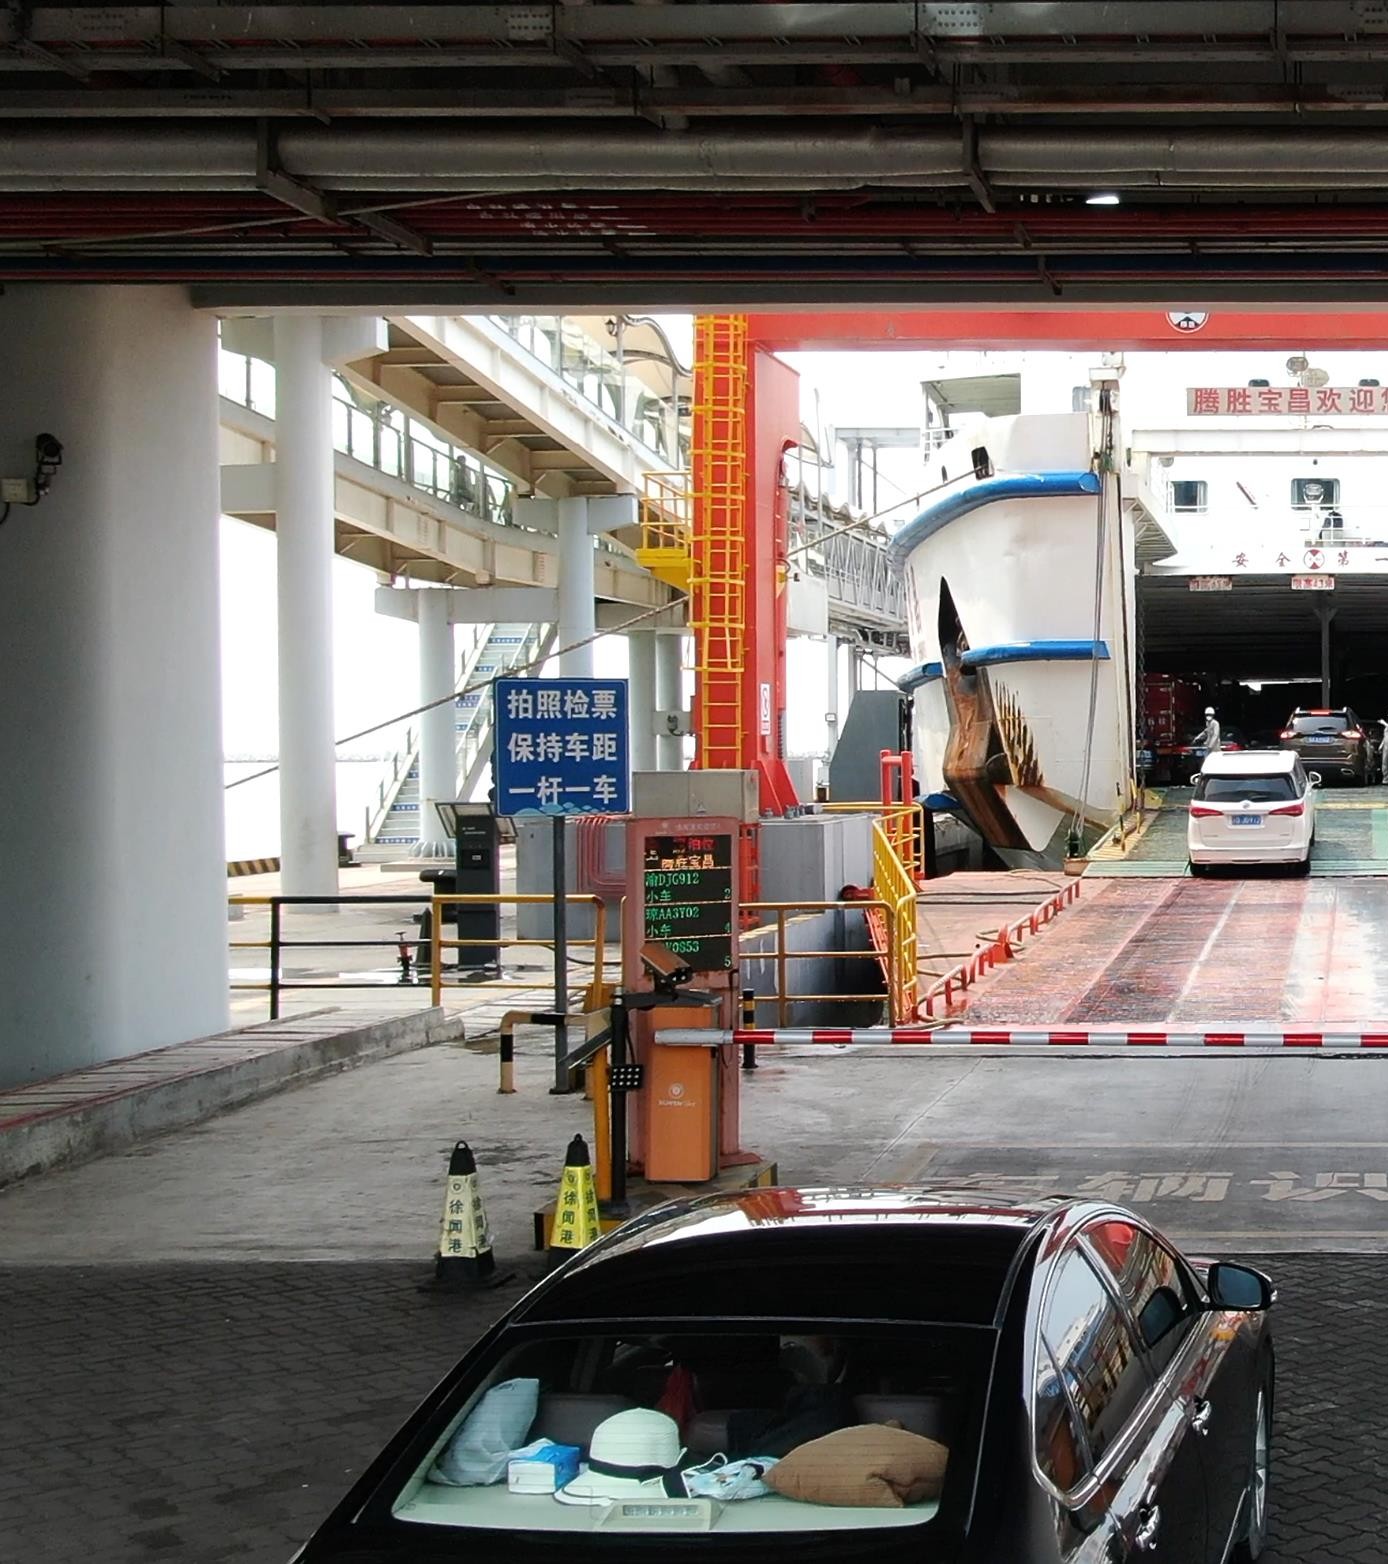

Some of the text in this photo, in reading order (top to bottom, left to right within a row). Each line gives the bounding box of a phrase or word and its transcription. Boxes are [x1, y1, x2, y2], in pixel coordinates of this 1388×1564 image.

[507, 689, 617, 719] 拍照检票
[507, 732, 617, 762] 保持车距
[508, 775, 618, 804] 一杆一车
[646, 889, 672, 904] 小车
[724, 956, 731, 968] 5
[448, 1200, 464, 1254] 徐闻港
[560, 1191, 576, 1245] 徐闻港
